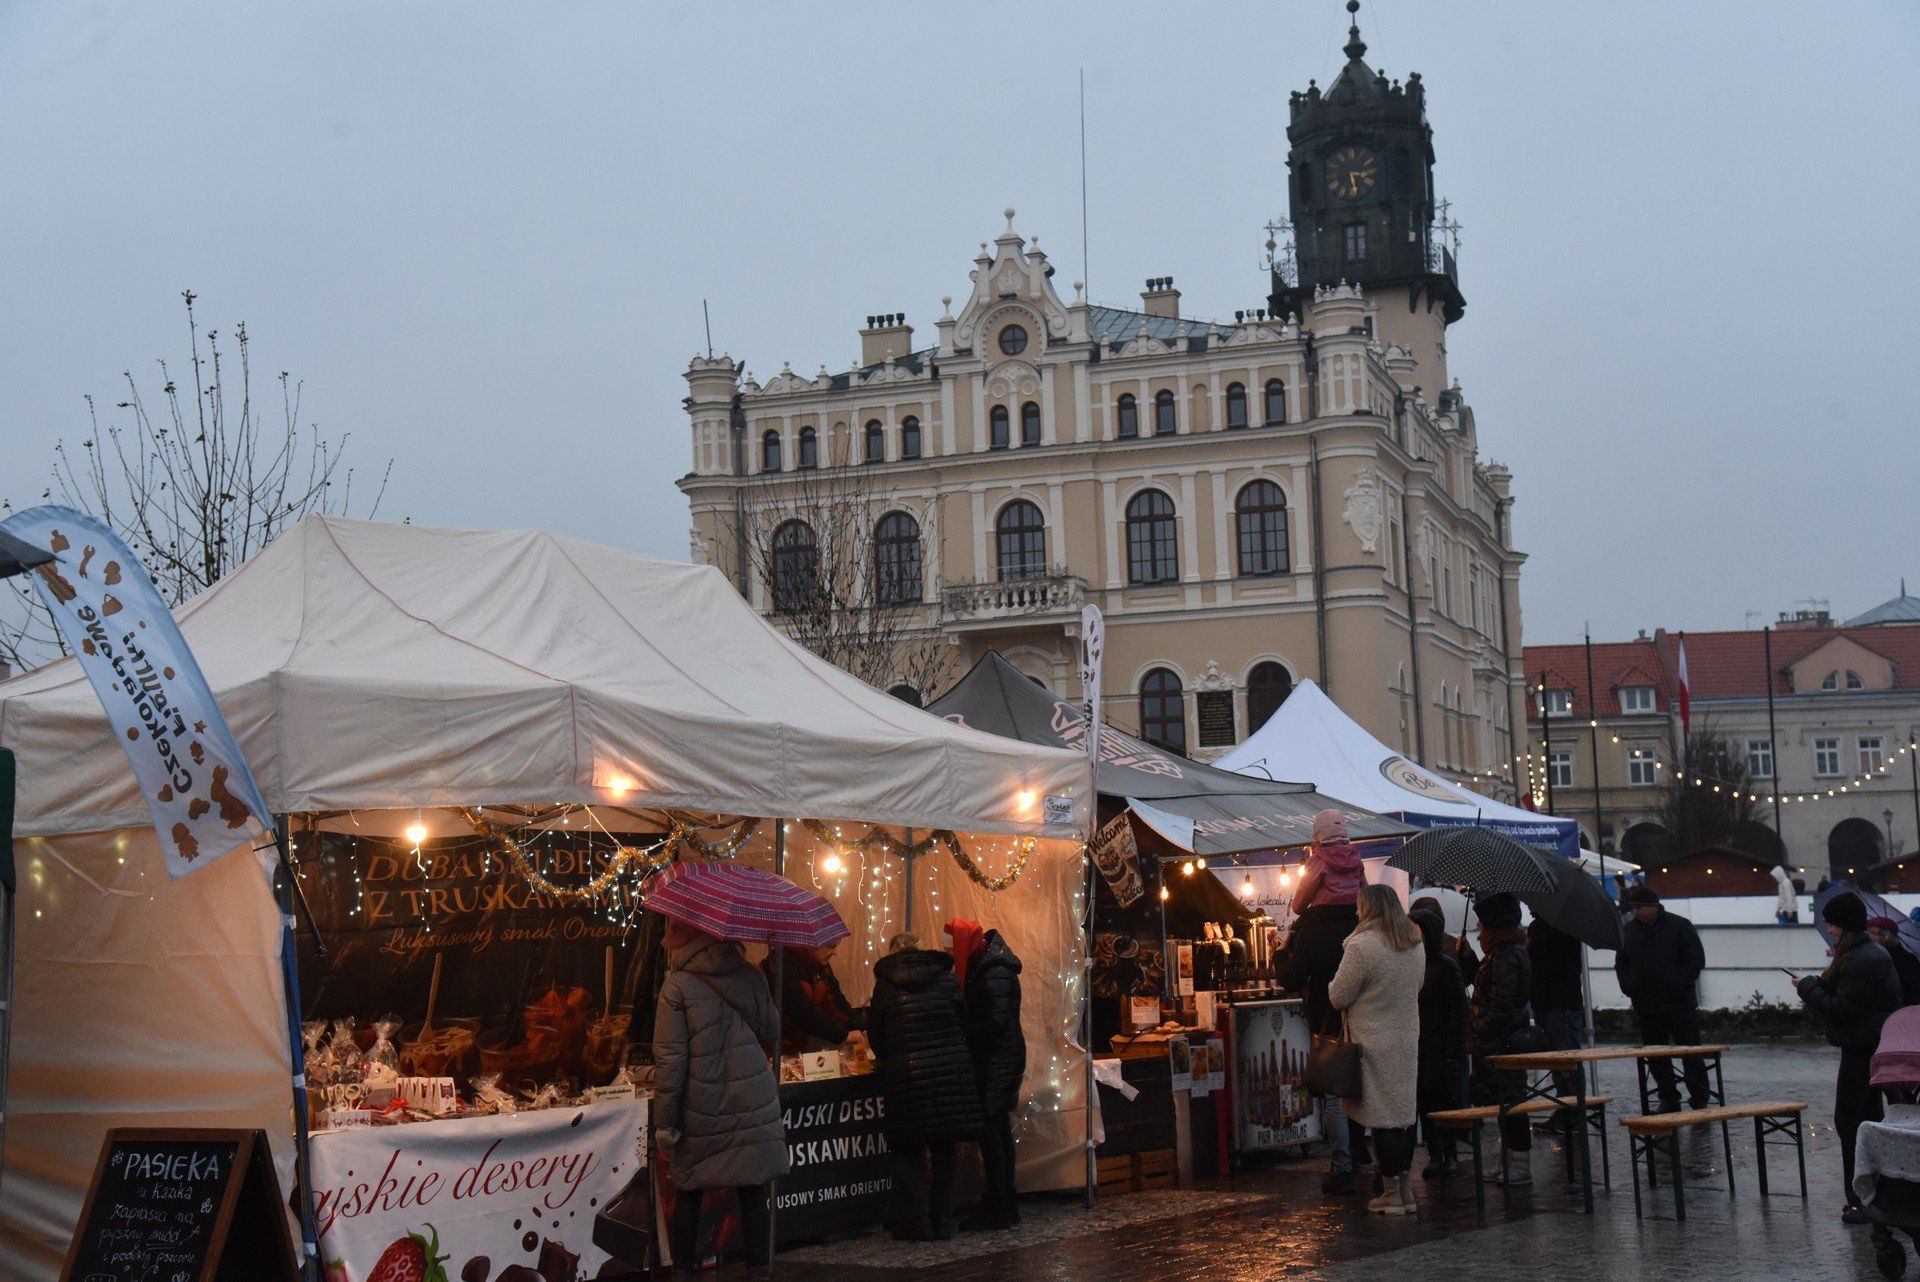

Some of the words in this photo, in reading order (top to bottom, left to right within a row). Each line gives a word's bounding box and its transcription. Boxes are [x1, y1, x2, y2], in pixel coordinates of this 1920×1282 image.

[370, 891, 394, 918] Z
[501, 918, 556, 942] smak
[123, 1151, 220, 1182] PASIEKA
[452, 1137, 600, 1209] desery
[818, 1184, 848, 1202] SMAK
[850, 1177, 893, 1196] ORIENTU
[175, 1211, 194, 1224] na
